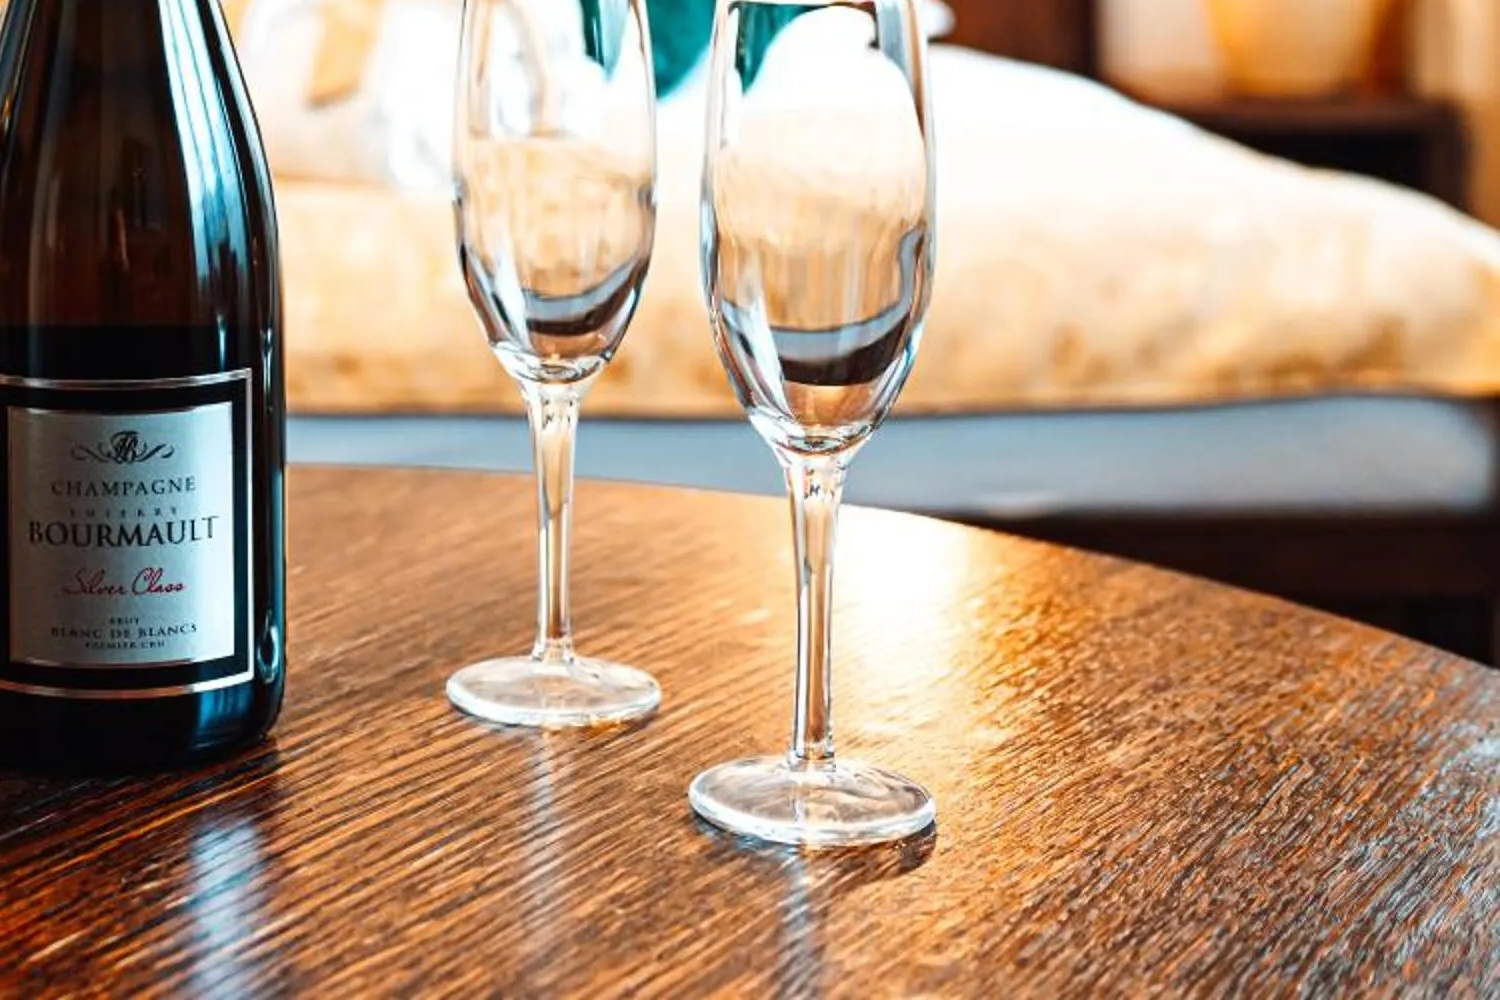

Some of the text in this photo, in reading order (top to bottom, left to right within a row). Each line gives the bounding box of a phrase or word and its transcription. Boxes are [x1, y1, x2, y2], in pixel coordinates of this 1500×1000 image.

[51, 476, 196, 498] CHAMPAGNE
[69, 506, 178, 517] THIERRY
[29, 515, 219, 547] BOURMAULT
[63, 567, 186, 595] Silver Class
[51, 623, 197, 639] BLANC DE BLANCS
